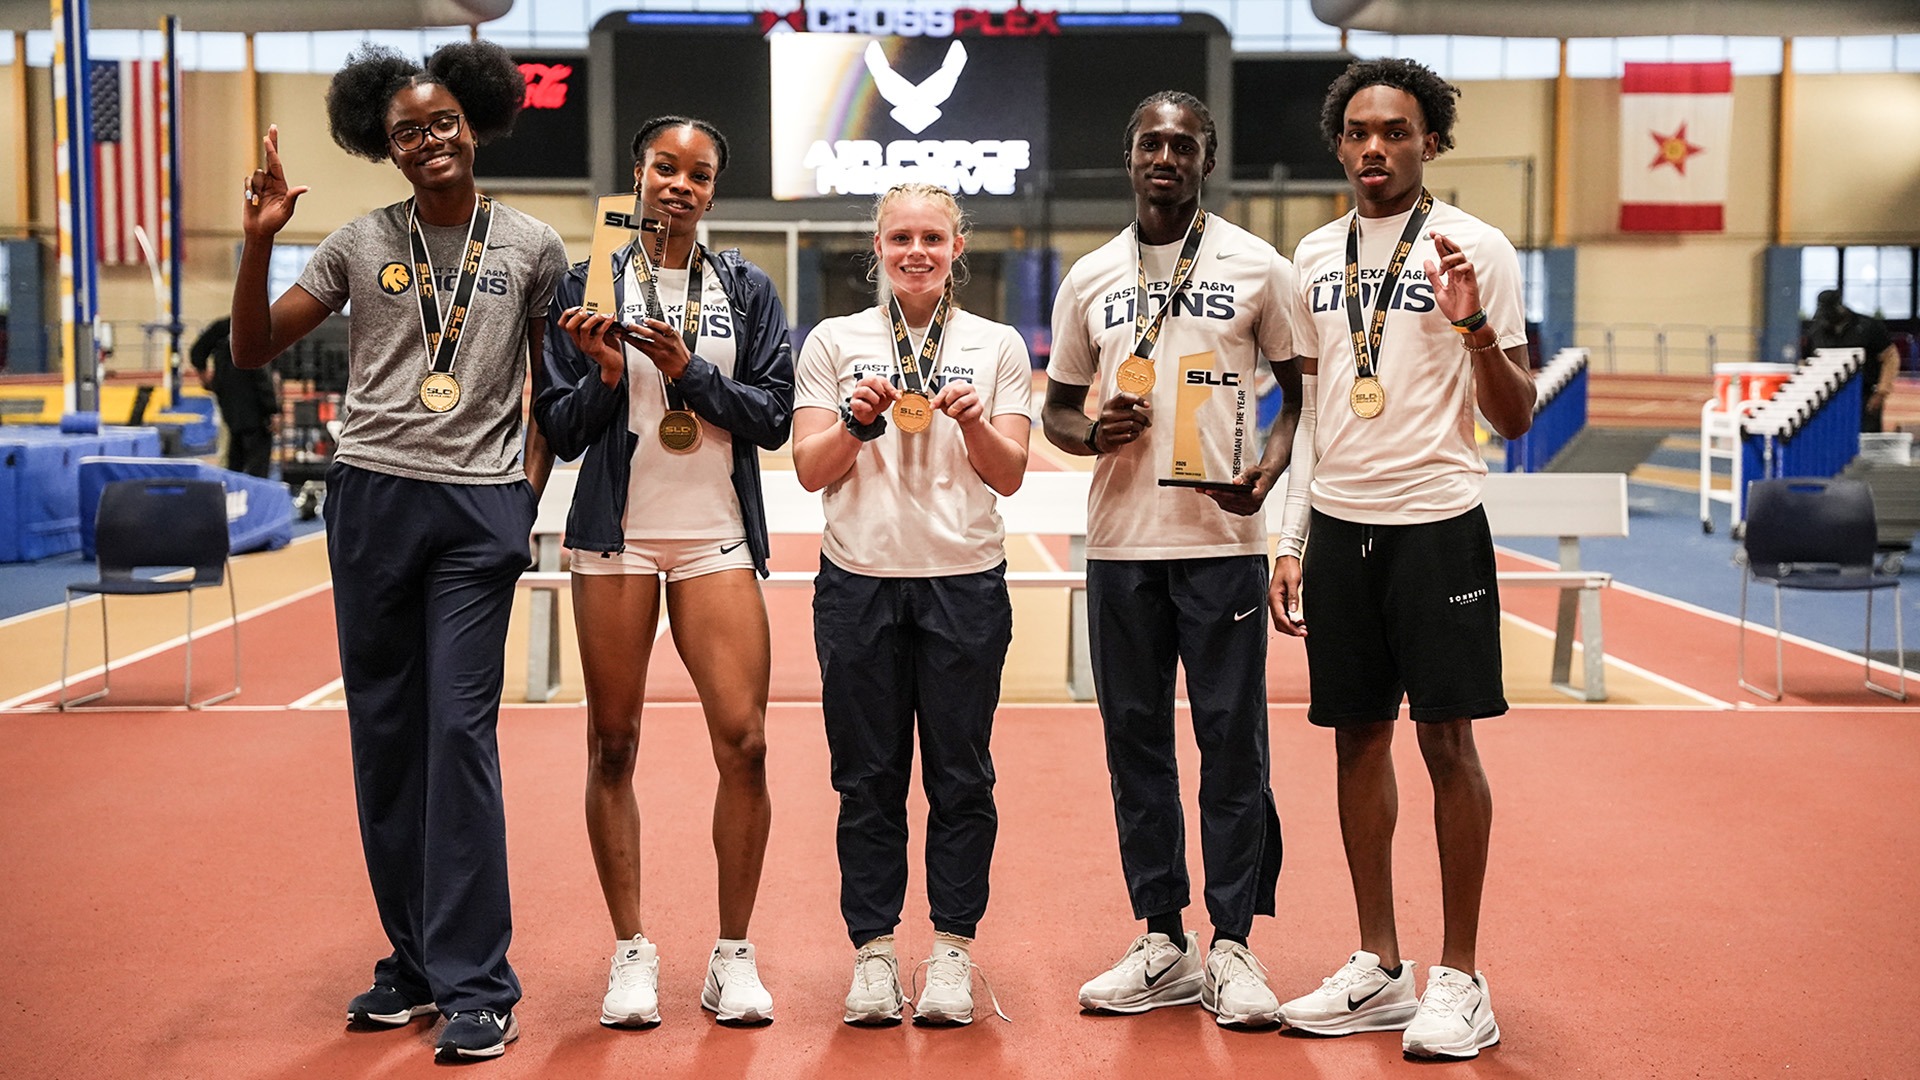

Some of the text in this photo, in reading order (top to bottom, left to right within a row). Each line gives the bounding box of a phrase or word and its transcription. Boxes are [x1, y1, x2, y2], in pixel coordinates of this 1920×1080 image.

[604, 211, 659, 234] SLC
[653, 237, 664, 257] YEAR
[651, 258, 661, 272] THE
[485, 269, 509, 279] A&M
[650, 273, 658, 284] OF
[1147, 281, 1193, 292] TEXS
[1200, 282, 1235, 293] A&M
[854, 364, 889, 372] EAST
[943, 366, 974, 375] A&M
[1187, 370, 1239, 386] SLC
[1237, 390, 1246, 410] YEAR
[900, 407, 924, 416] SLC
[1236, 412, 1245, 426] THE
[1235, 427, 1243, 437] OF
